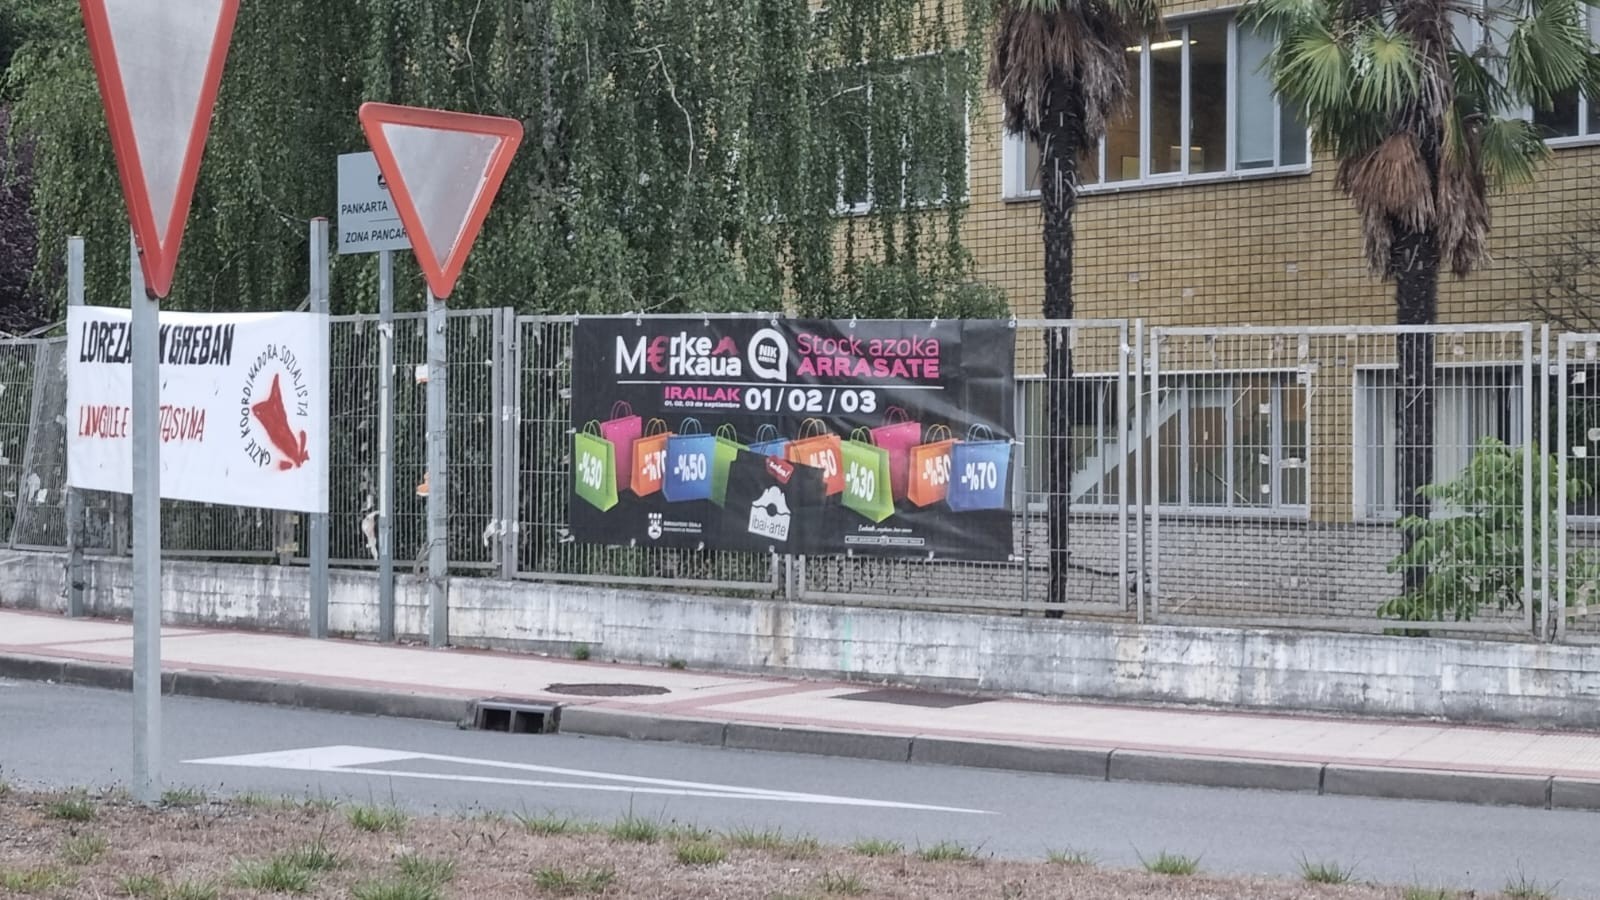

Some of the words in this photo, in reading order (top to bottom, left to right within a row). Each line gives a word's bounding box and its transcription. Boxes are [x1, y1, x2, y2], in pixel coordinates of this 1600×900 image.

[341, 200, 388, 215] PANKARTA
[345, 231, 369, 243] ZONA
[371, 227, 408, 241] PANCAR
[759, 344, 778, 358] NIK
[797, 334, 863, 356] Stock
[868, 335, 940, 357] azoka
[796, 357, 940, 379] ARRASATE
[664, 386, 741, 402] IRAILAK
[79, 405, 130, 438] LANGILEE
[579, 450, 603, 491] -%30
[674, 453, 707, 482] -%50
[961, 461, 997, 491] -%70
[846, 460, 875, 502] -%30
